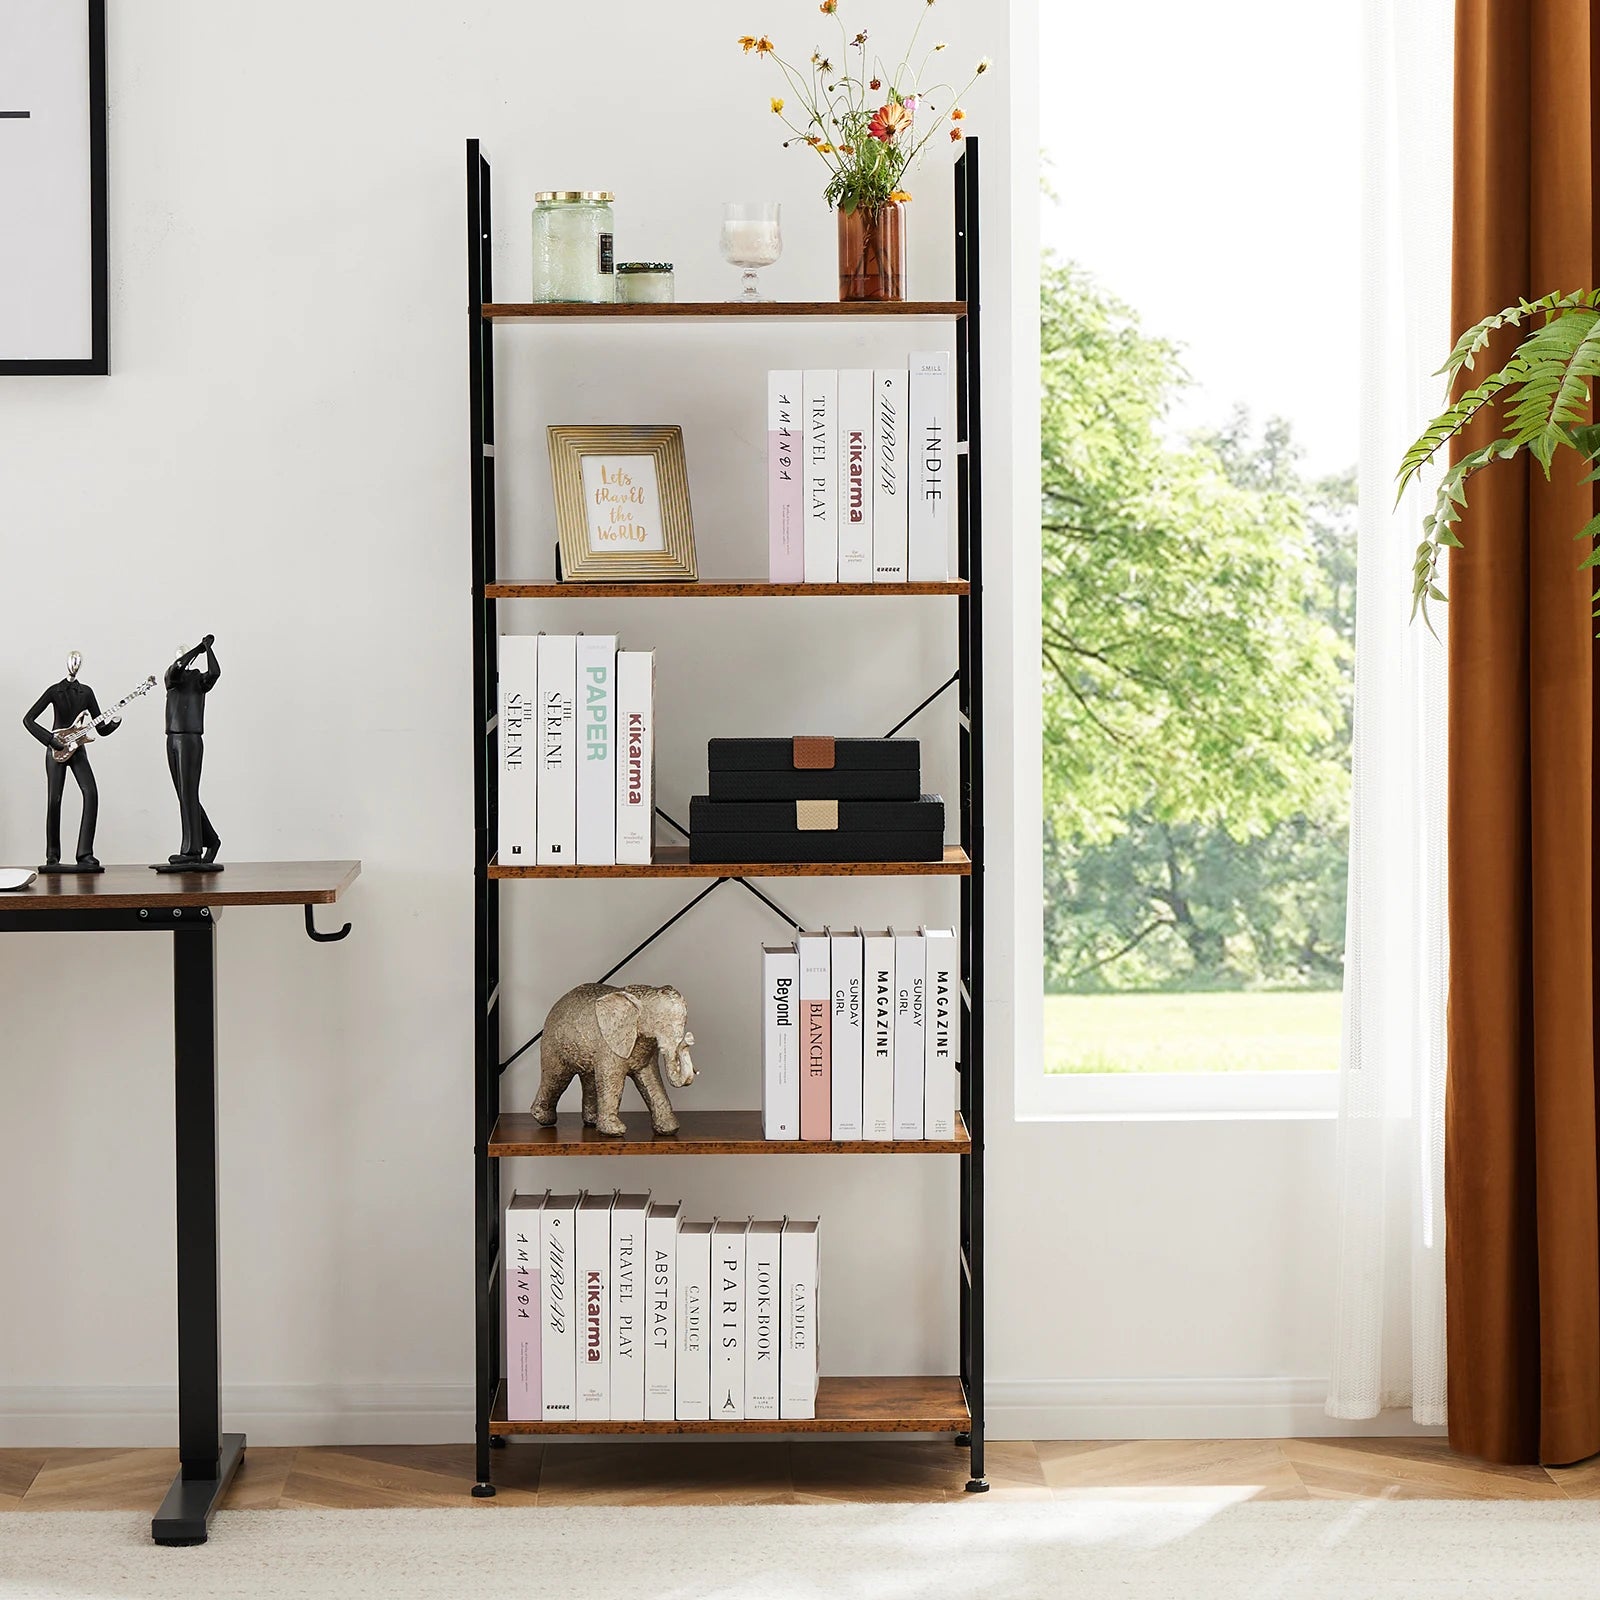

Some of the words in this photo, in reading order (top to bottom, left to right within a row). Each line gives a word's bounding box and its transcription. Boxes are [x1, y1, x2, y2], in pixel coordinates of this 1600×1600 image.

[779, 394, 792, 481] AMANDA
[812, 395, 826, 465] TRAVEL
[926, 427, 942, 500] INDIE
[609, 505, 633, 524] the
[812, 478, 826, 521] PLAY
[507, 692, 522, 771] SERENE
[523, 700, 532, 723] THE
[546, 691, 562, 770] SERENE
[563, 699, 572, 722] THE
[586, 667, 607, 761] PAPER
[773, 978, 792, 1027] Beyond
[836, 990, 845, 1015] GIRL
[850, 978, 859, 1027] SUNDAY
[876, 970, 889, 1057] MAGAZINE
[900, 989, 909, 1015] GIRL
[913, 978, 923, 1027] SUNDAY
[936, 971, 949, 1058] MAGAZINE
[810, 1003, 823, 1077] BLANCHE
[517, 1233, 530, 1318] AMANDA
[619, 1234, 633, 1303] TRAVEL
[653, 1250, 669, 1349] ABSTRACT
[619, 1316, 633, 1358] PLAY
[688, 1285, 700, 1352] CANDICE
[722, 1259, 738, 1348] PARIS
[757, 1262, 771, 1361] LOOK-BOOK
[794, 1283, 805, 1350] CANDICE
